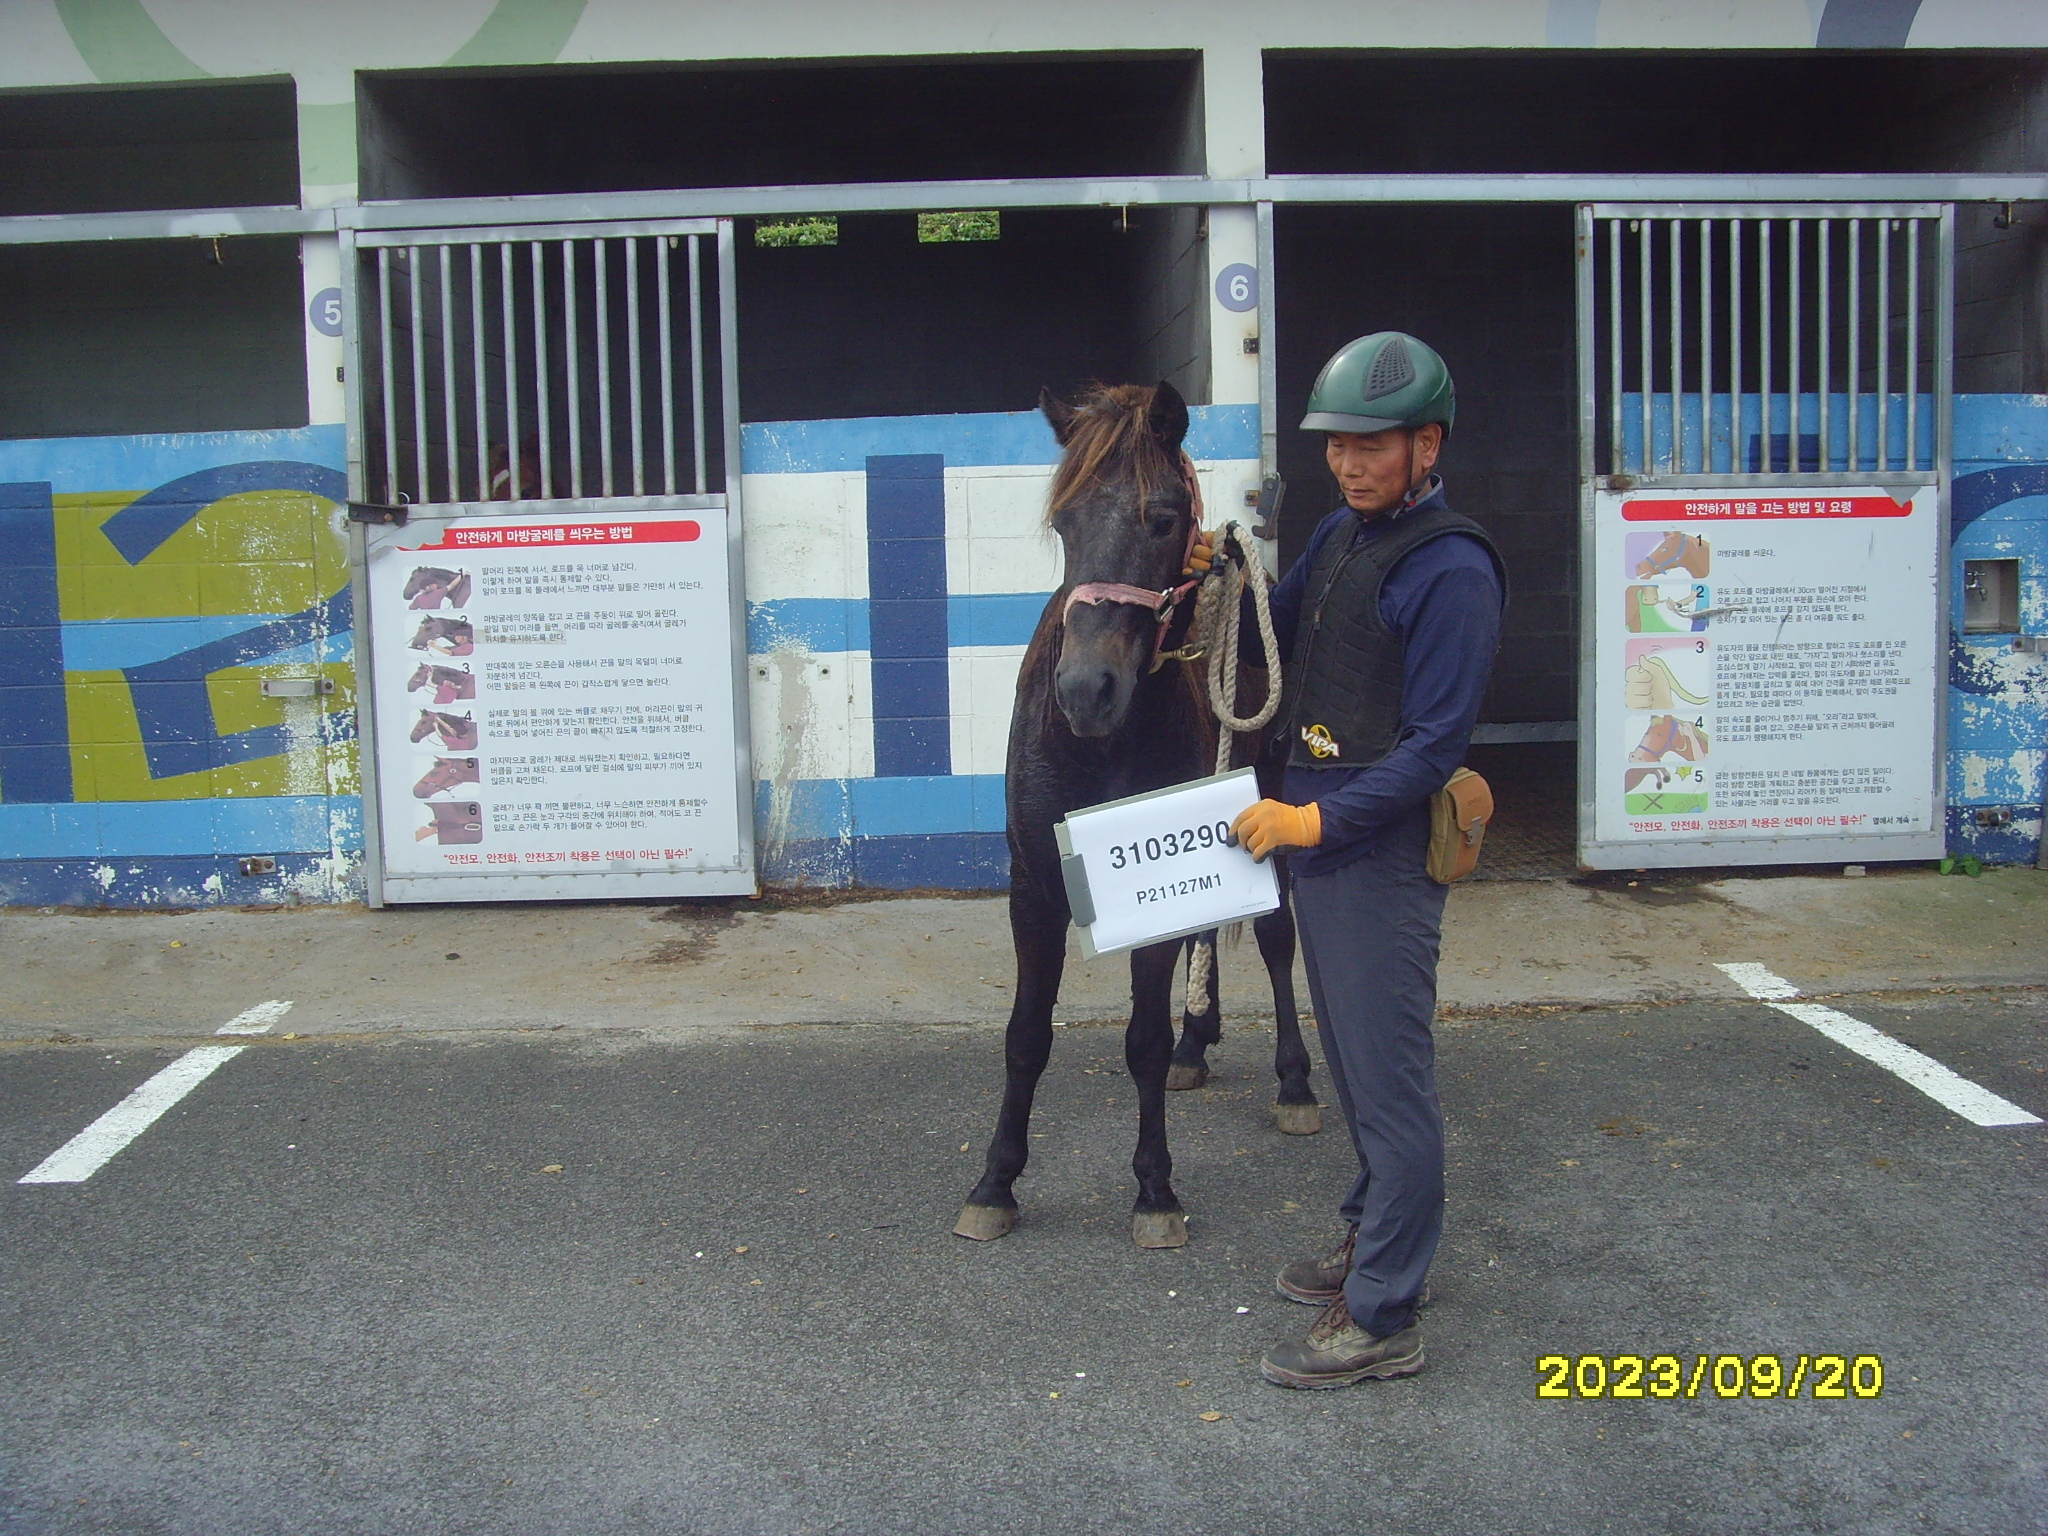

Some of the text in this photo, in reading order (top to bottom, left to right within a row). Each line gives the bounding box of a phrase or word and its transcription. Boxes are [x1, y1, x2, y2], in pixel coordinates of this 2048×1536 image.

[1230, 275, 1249, 301] 6
[324, 300, 341, 324] 5
[1684, 500, 1851, 515] 안전하게 말을 끄는 방법 및 요령
[455, 525, 632, 544] 안전하게 마방굴레를 씌우는 방법
[1696, 534, 1702, 546] 1
[458, 568, 464, 578] 1
[1696, 585, 1705, 598] 2
[459, 615, 468, 625] 2
[1695, 641, 1705, 653] 3
[462, 663, 470, 674] 3
[463, 710, 473, 721] 4
[1694, 716, 1705, 728] 4
[1301, 725, 1341, 758] VIPA
[466, 758, 475, 769] 5
[1694, 770, 1704, 782] 5
[468, 804, 477, 815] 6
[1670, 819, 1703, 831] 안전화,
[1707, 818, 1747, 830] 안전조끼
[1750, 817, 1780, 828] 착용은
[1783, 816, 1813, 827] 선택이
[1816, 815, 1836, 826] 아닌
[1110, 820, 1229, 871] 3103290
[486, 852, 520, 864] 안전화,
[524, 851, 566, 862] 안전조끼
[569, 850, 601, 862] 착용은
[604, 849, 635, 861] 선택이
[639, 849, 660, 860] 아닌
[1136, 873, 1223, 905] P21127M1
